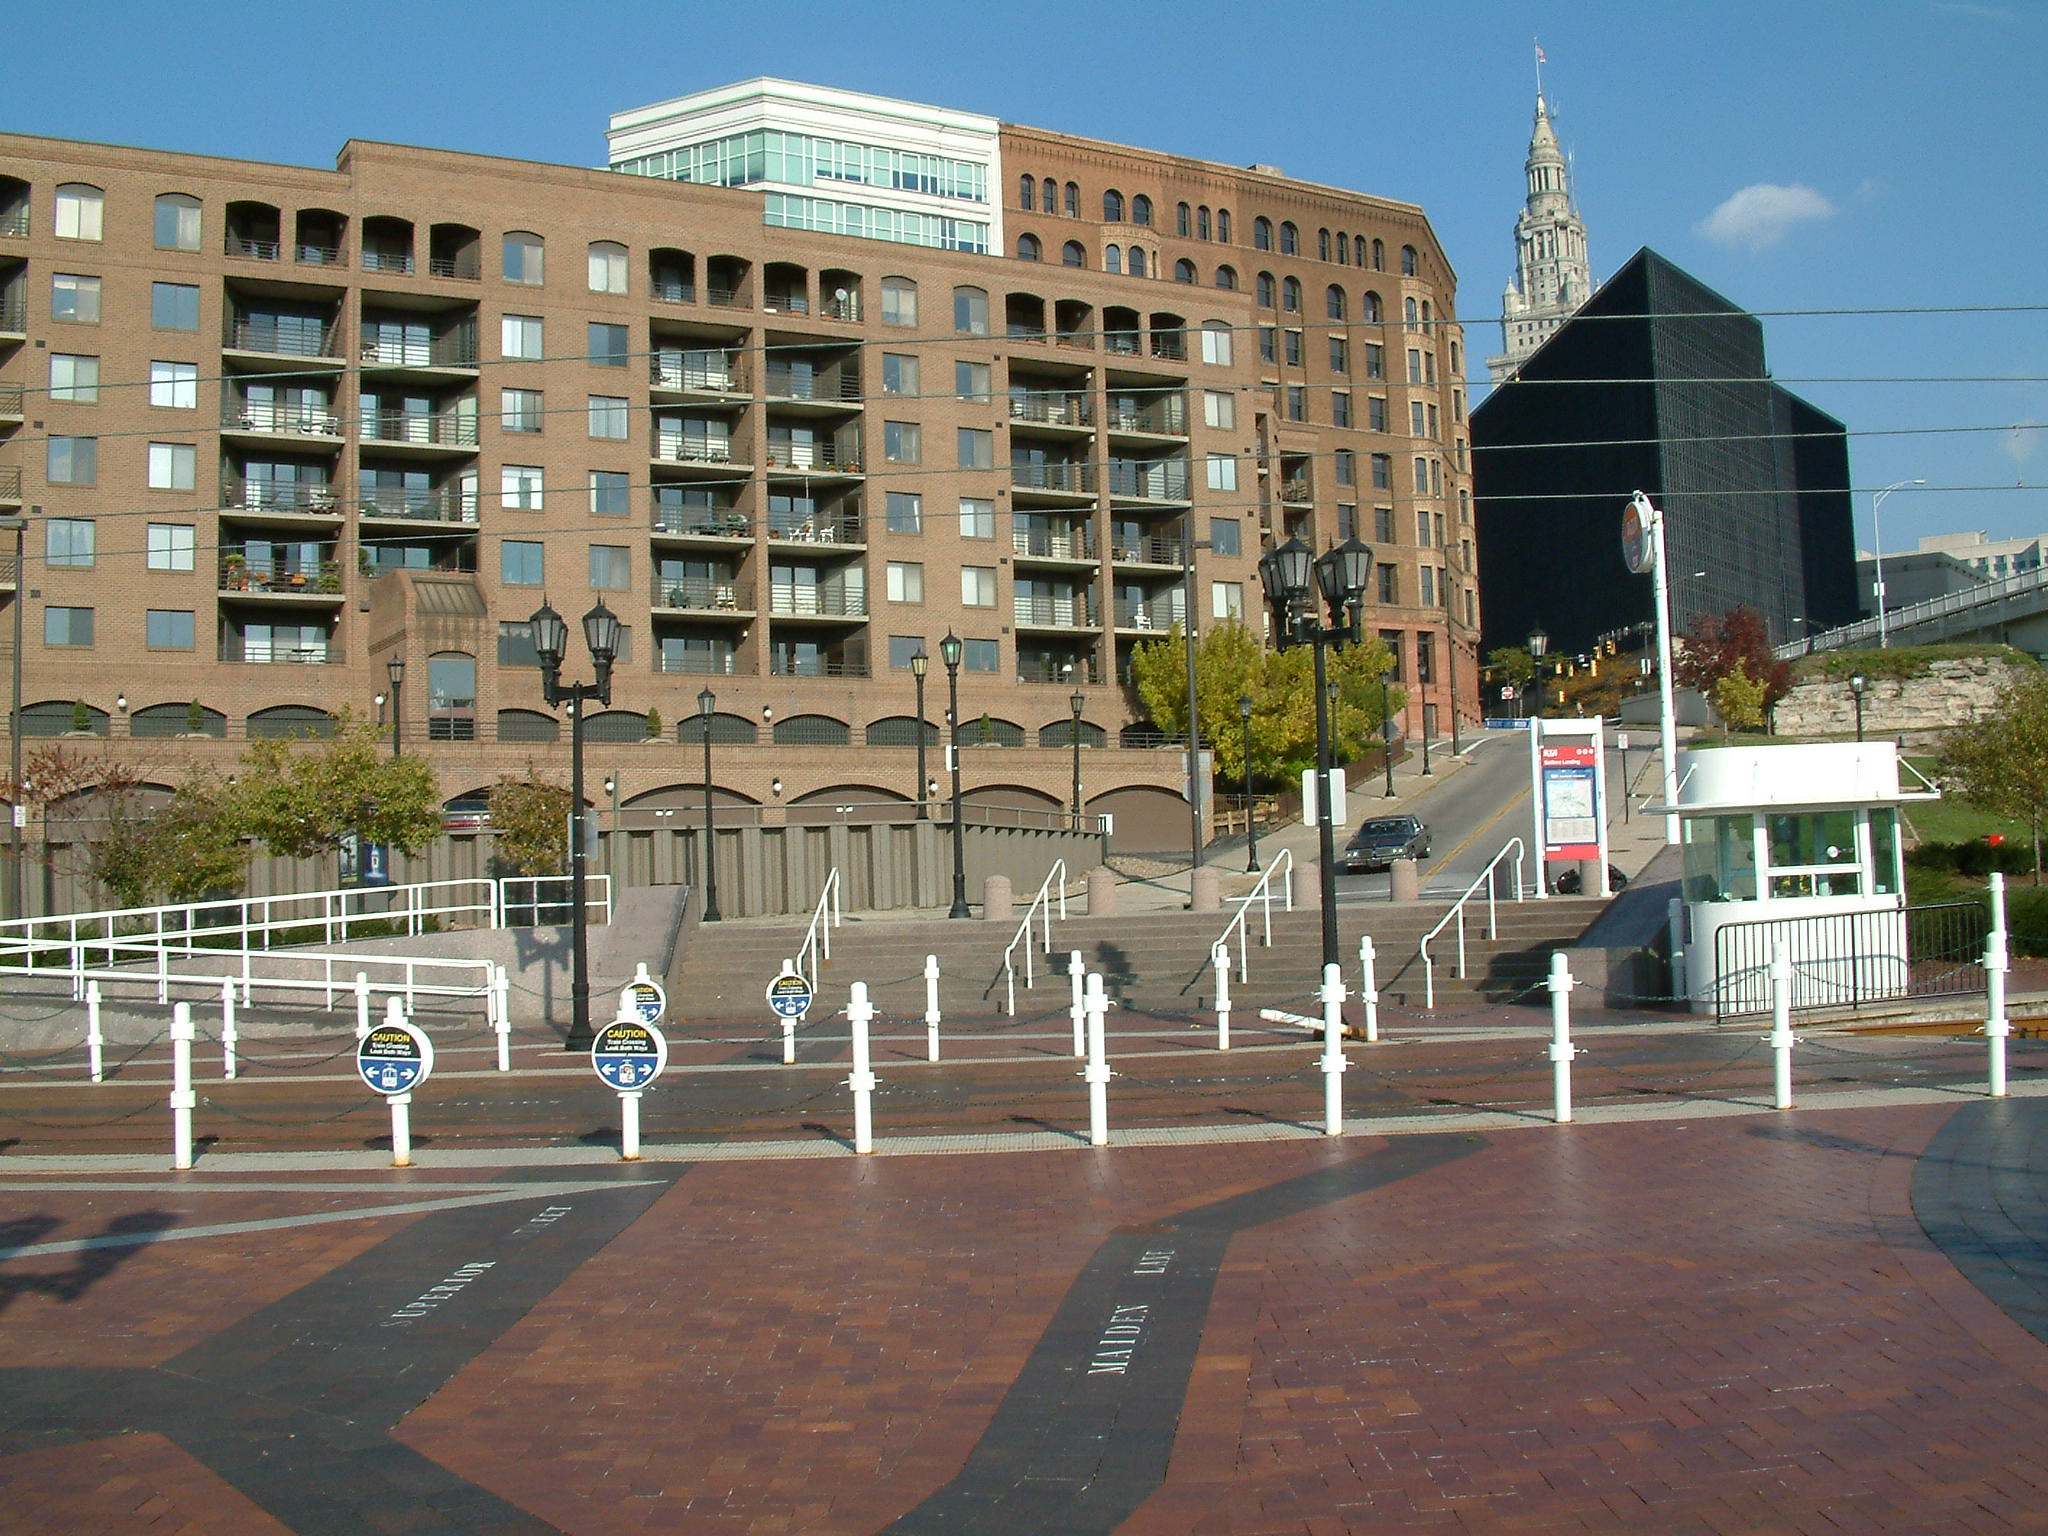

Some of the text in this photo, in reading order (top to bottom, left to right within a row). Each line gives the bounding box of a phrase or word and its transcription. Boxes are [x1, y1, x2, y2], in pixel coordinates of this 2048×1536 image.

[371, 1033, 411, 1043] CAUTION
[607, 1028, 647, 1039] CAUTION
[380, 1261, 496, 1328] SUPERIOR
[1087, 1305, 1148, 1375] MAIDEN
